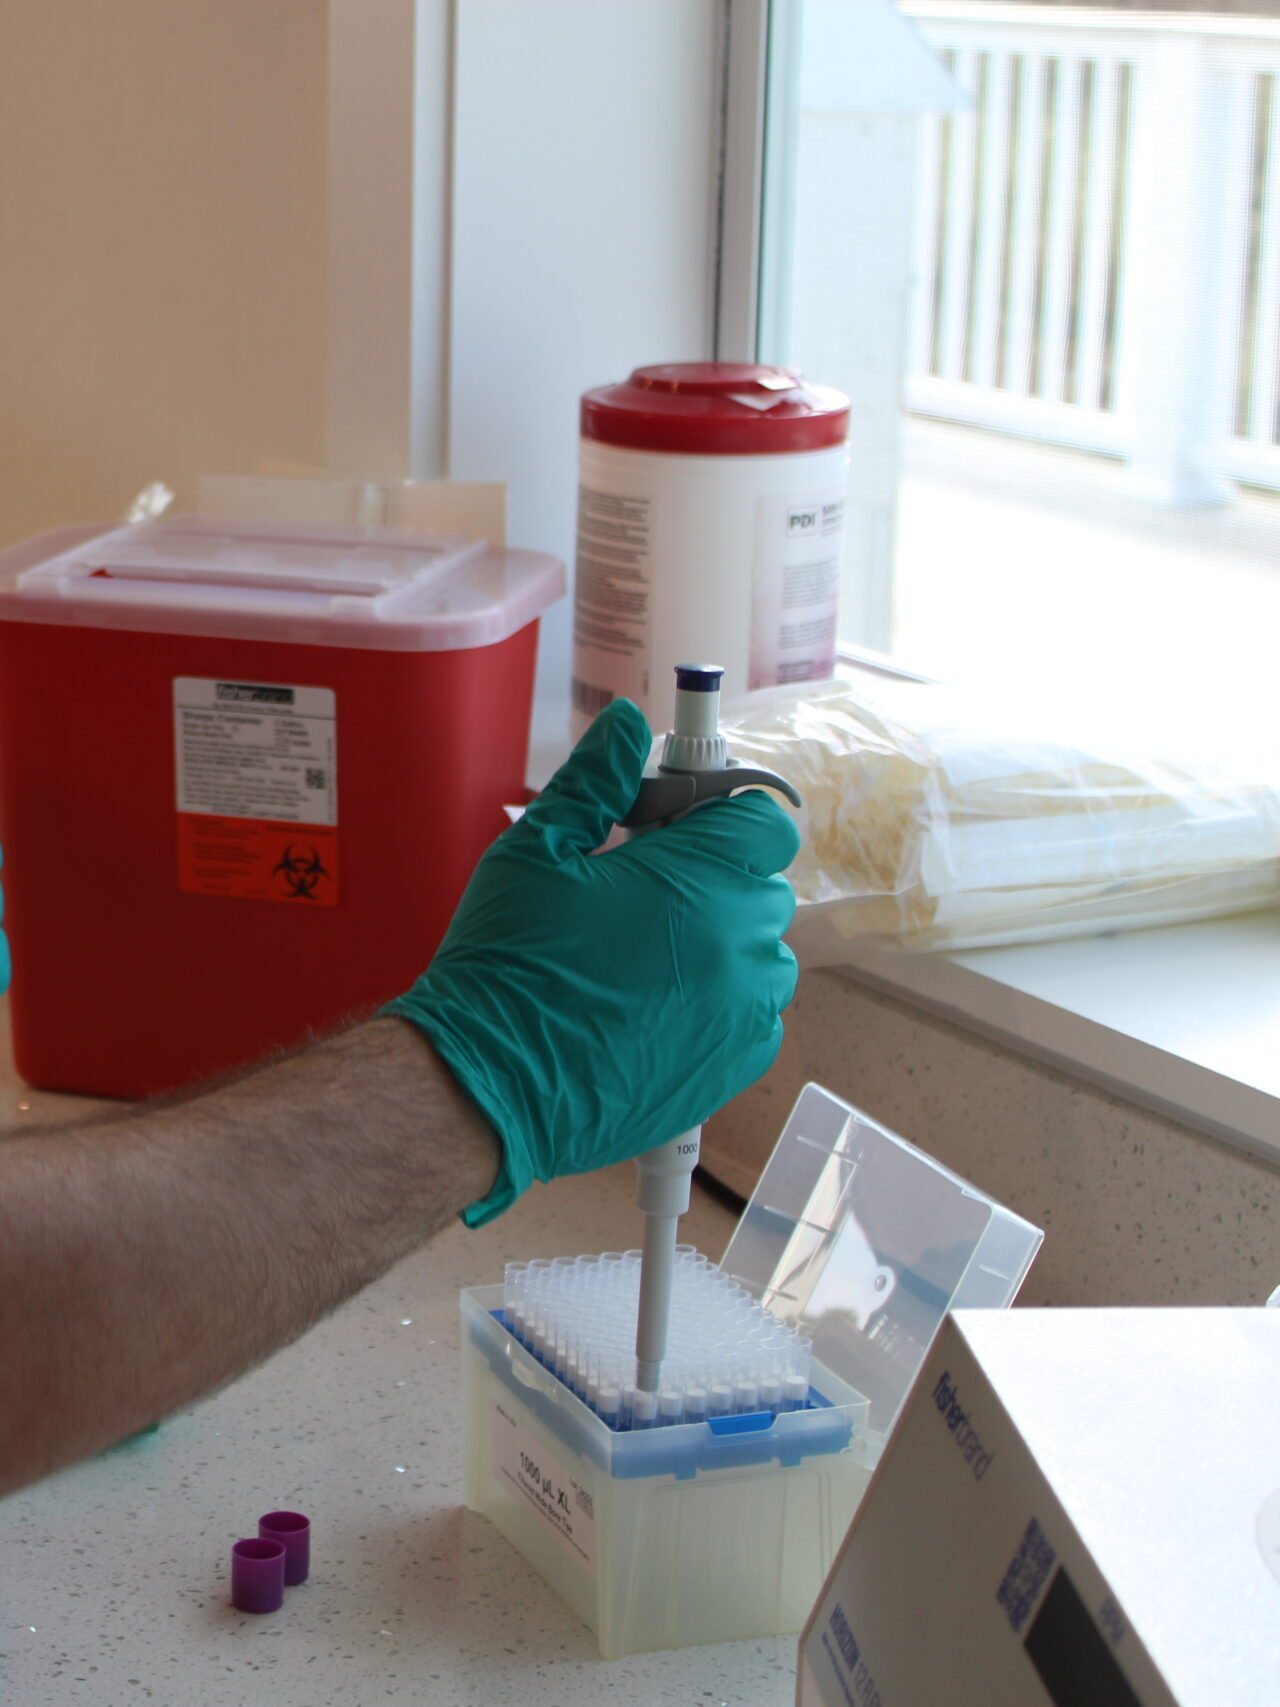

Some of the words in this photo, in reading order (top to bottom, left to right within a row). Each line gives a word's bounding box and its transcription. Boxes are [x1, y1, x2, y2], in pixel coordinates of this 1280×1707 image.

[789, 513, 816, 530] PDI
[676, 1143, 698, 1155] 1000
[932, 1371, 994, 1482] fisherbrand
[519, 1451, 540, 1486] 1000
[557, 1487, 571, 1515] XL
[829, 1602, 861, 1673] HORIZON
